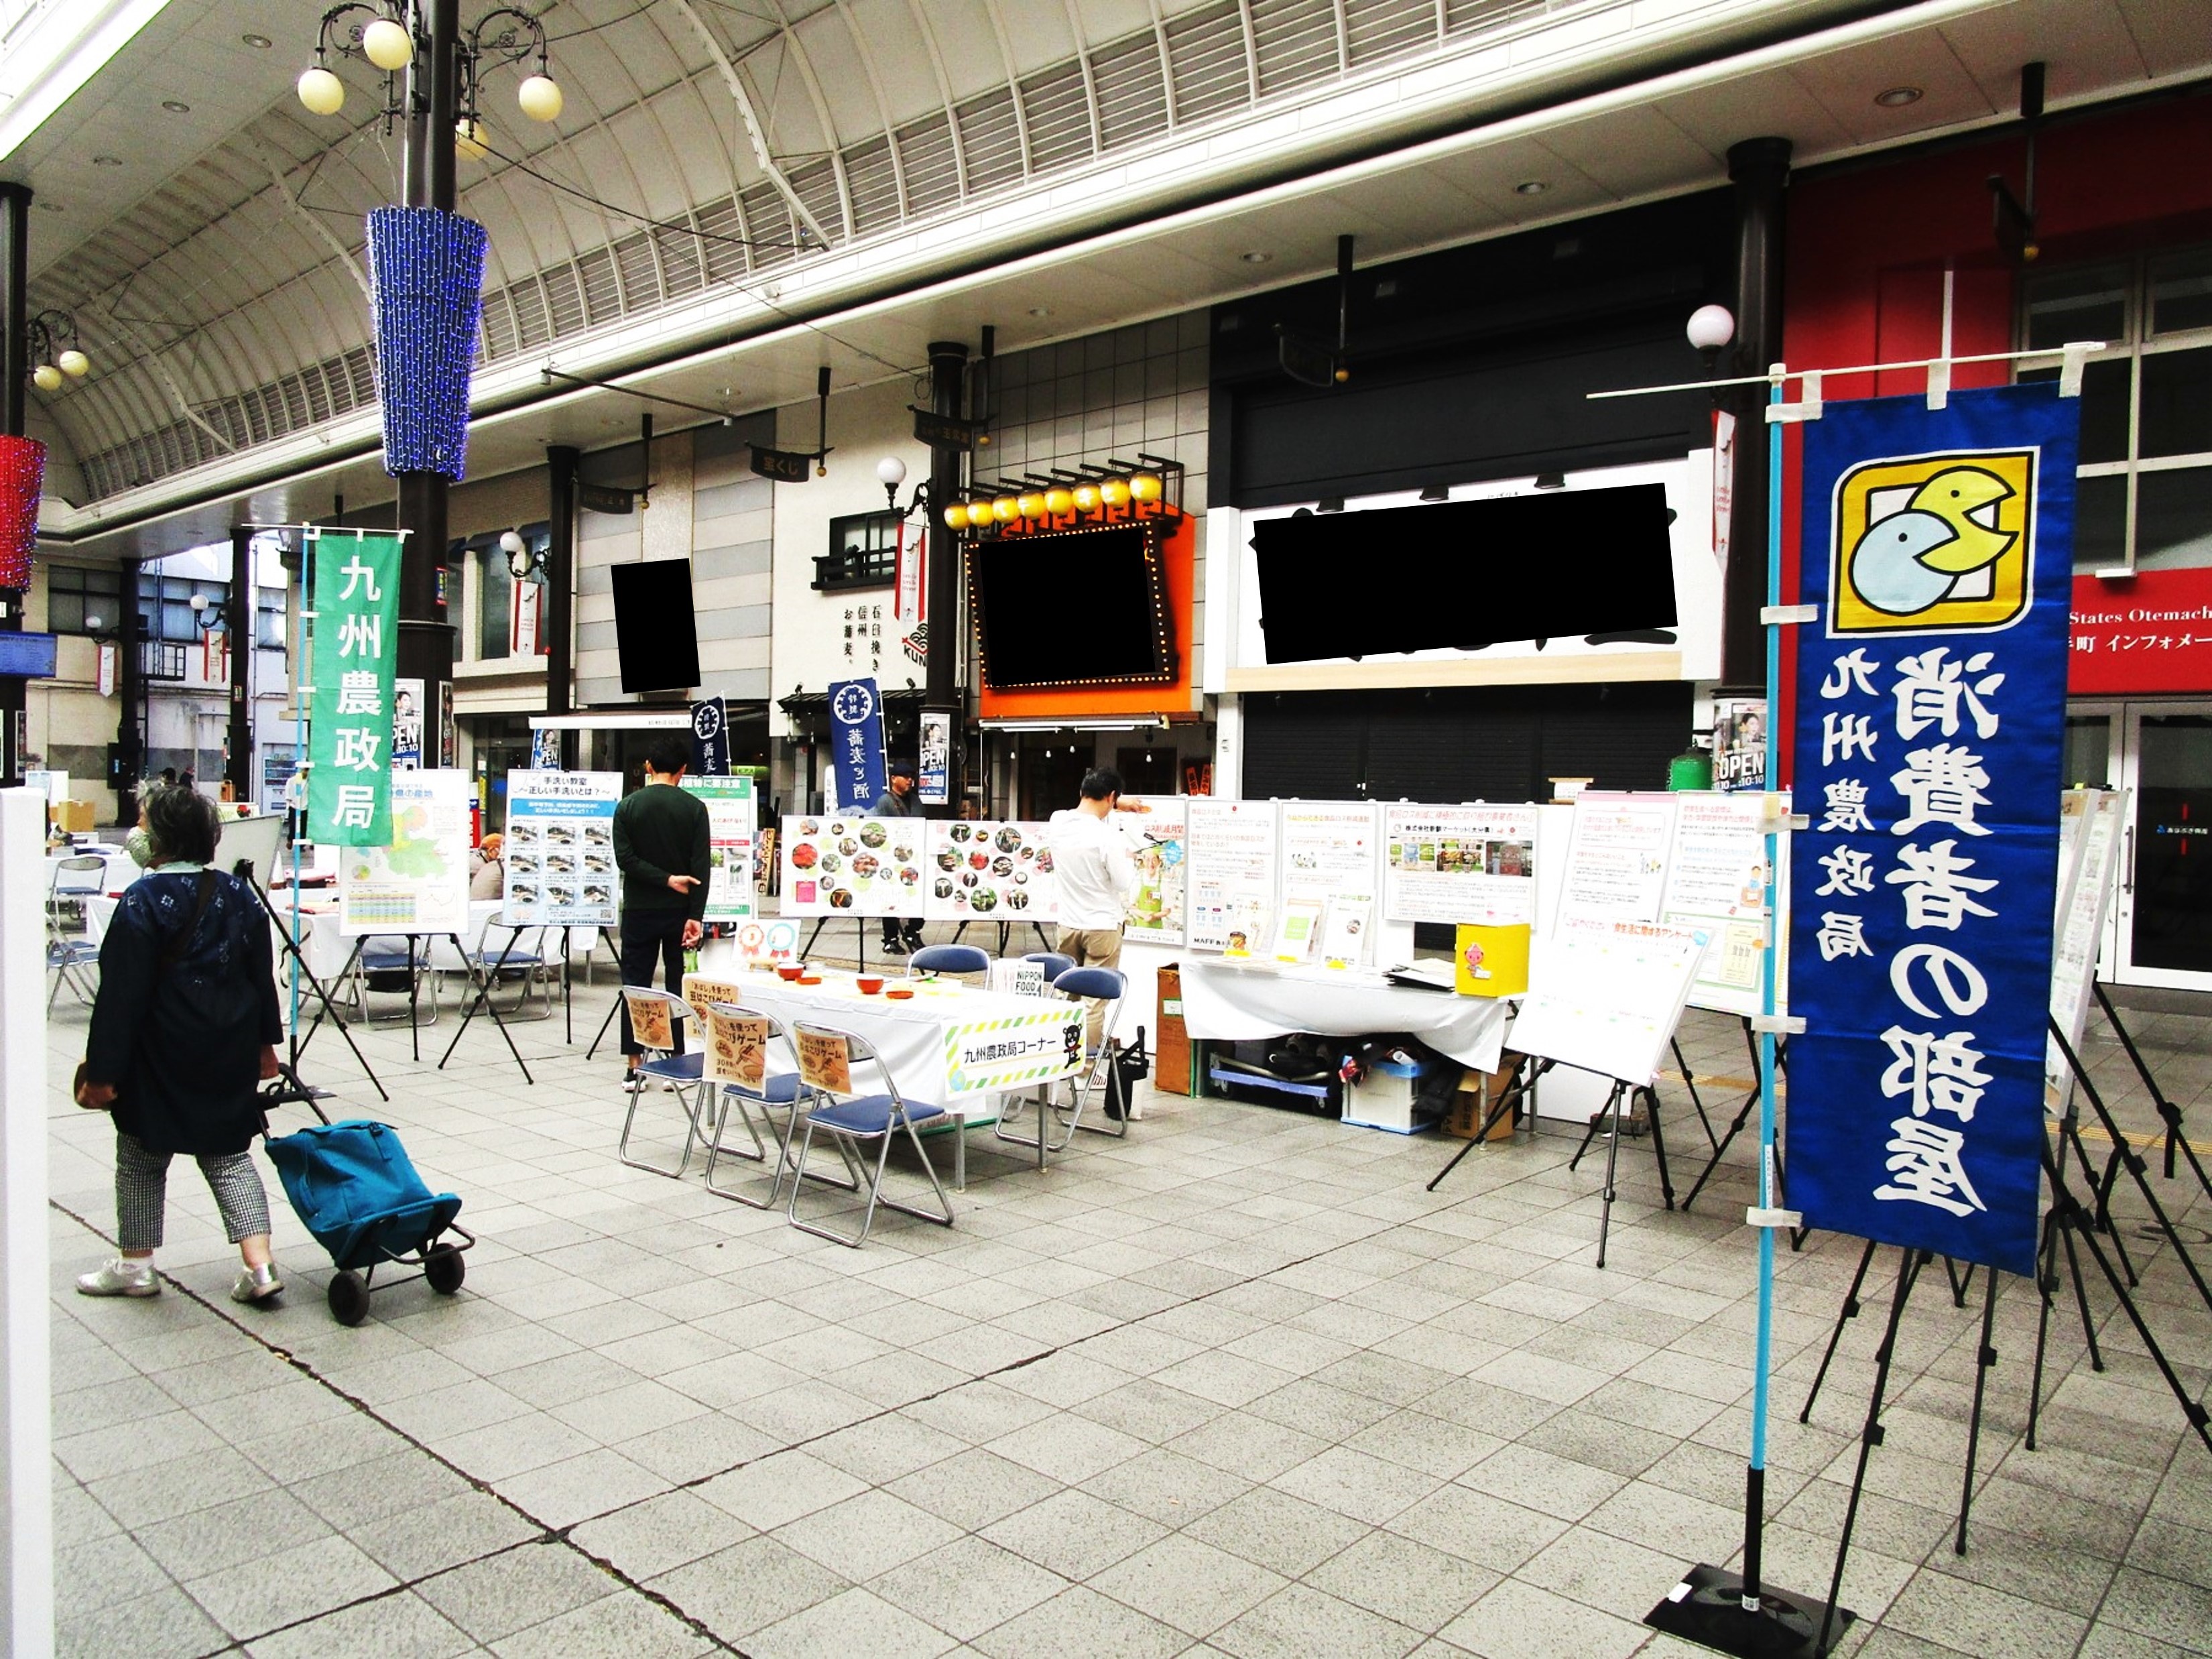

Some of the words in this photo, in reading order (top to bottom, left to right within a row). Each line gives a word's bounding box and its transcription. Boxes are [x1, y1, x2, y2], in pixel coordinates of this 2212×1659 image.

[763, 456, 798, 475] 宝くじ
[857, 605, 868, 637] 信州
[2069, 611, 2123, 625] States
[871, 605, 881, 672] 石臼挽き
[332, 555, 382, 829] 九州農政局
[1719, 751, 1764, 780] OPEN
[544, 776, 587, 786] 手洗い教室
[1015, 981, 1036, 991] FOOD
[1016, 971, 1043, 981] NIPPON
[964, 1037, 1056, 1064] 九州農政局コーナー
